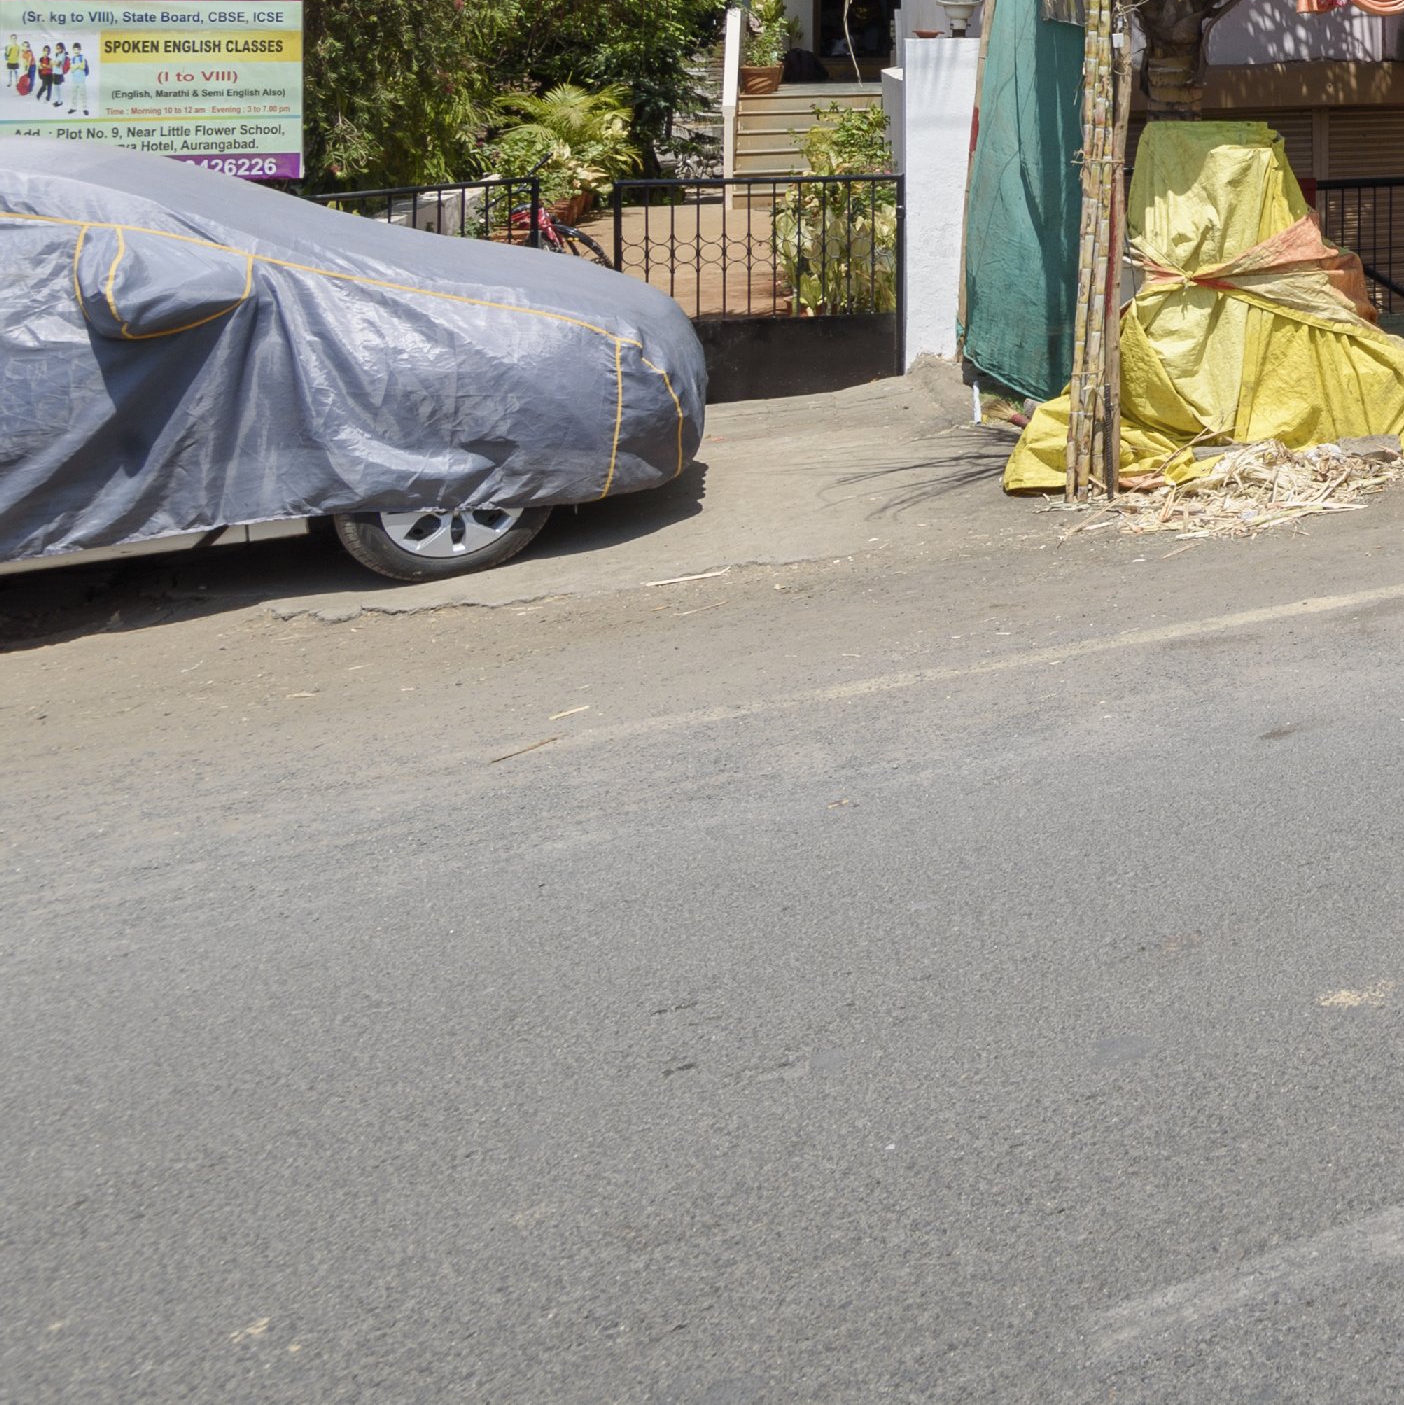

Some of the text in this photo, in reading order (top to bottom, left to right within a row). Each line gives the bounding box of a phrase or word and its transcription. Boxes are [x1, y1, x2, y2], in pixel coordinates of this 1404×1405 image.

[22, 11, 284, 24] (Sr. kg to VIII), State Board, CBSE, ICSE
[104, 40, 284, 53] SPOKEN ENGLISH CLASSES
[157, 70, 238, 85] (I to VIII)
[112, 87, 286, 100] (English, Marathi & Semi English Also)
[56, 128, 83, 139] Plot
[86, 128, 108, 139] No.
[111, 127, 123, 139] 9,
[126, 126, 157, 137] Near
[160, 126, 191, 137] Little
[195, 125, 237, 136] Flower
[240, 124, 285, 136] School,
[141, 140, 177, 152] Hotel,
[180, 138, 259, 152] Aurangabad.
